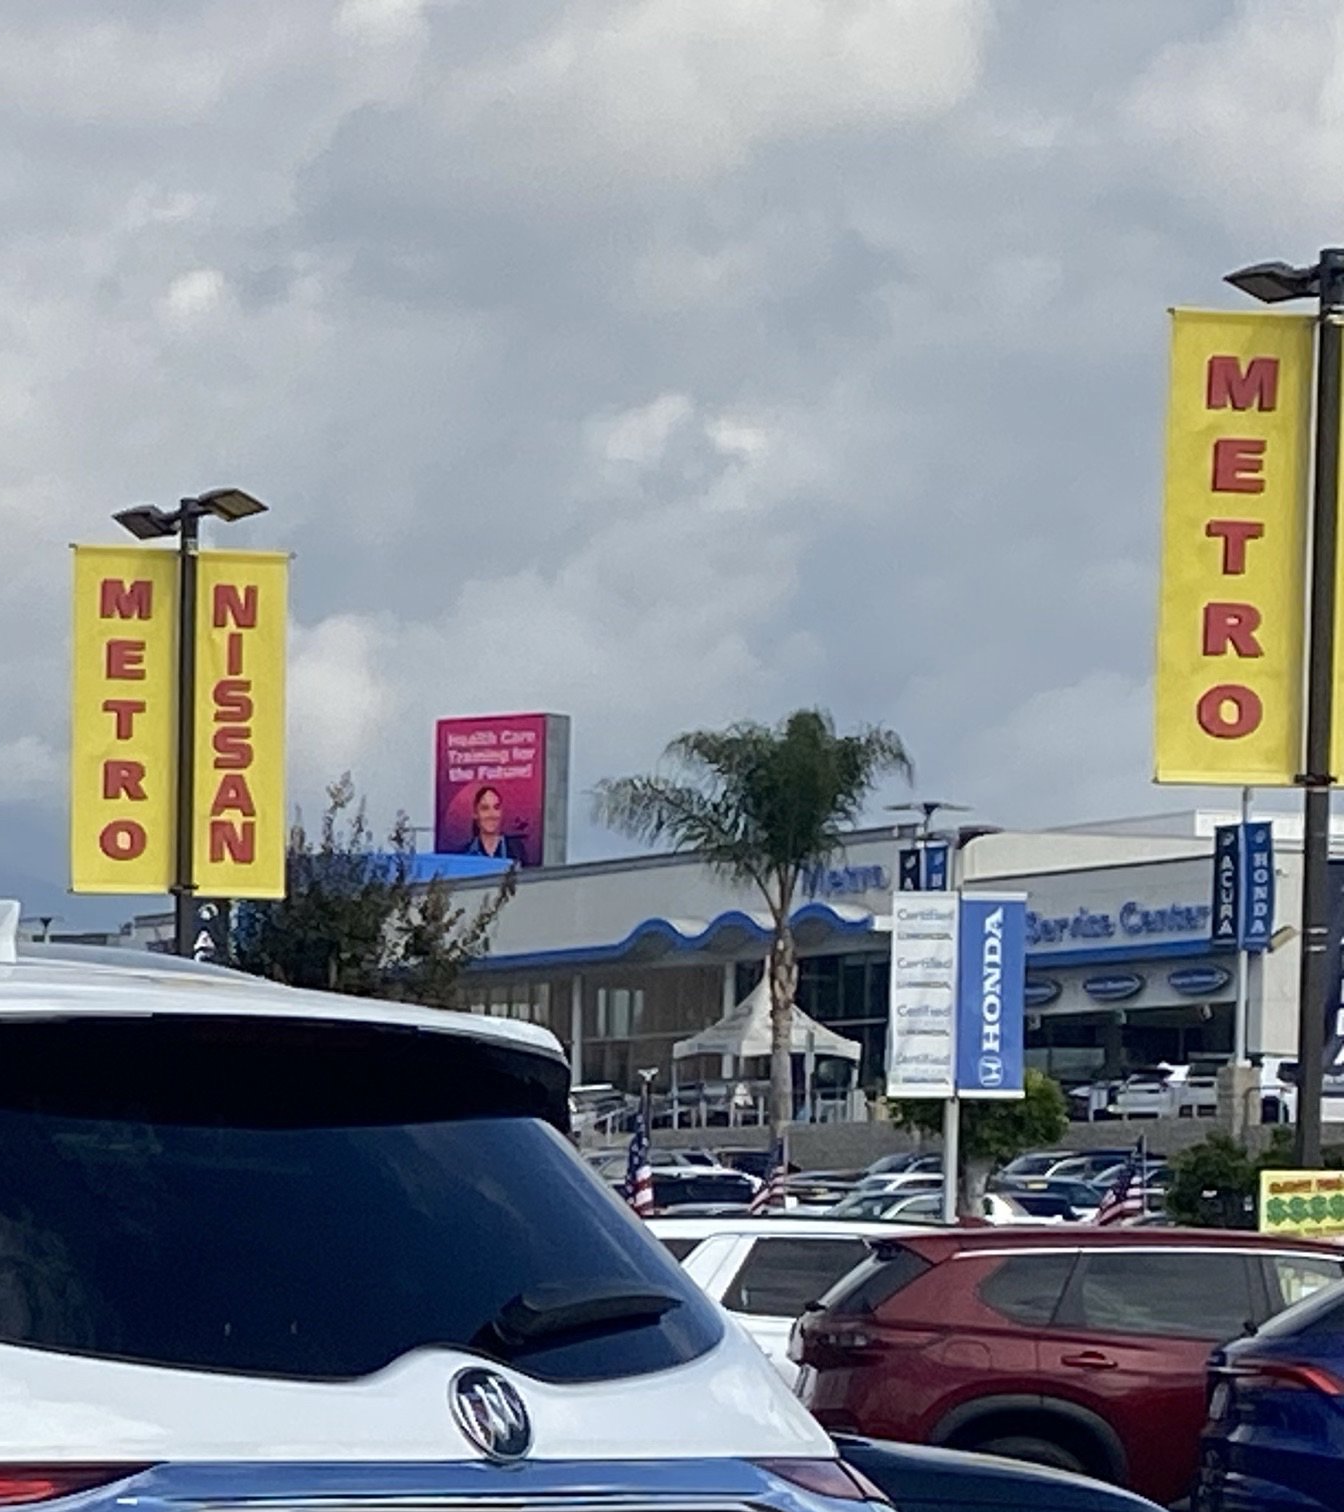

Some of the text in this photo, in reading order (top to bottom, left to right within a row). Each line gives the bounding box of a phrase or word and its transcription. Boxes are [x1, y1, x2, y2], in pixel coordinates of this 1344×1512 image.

[1197, 355, 1280, 739] METRO
[99, 578, 153, 861] METRO
[210, 583, 258, 864] NISSAN
[1119, 901, 1212, 935] Center
[1218, 855, 1234, 935] ACURA
[1250, 852, 1268, 934] HONDA
[981, 906, 1005, 1054] HONDA
